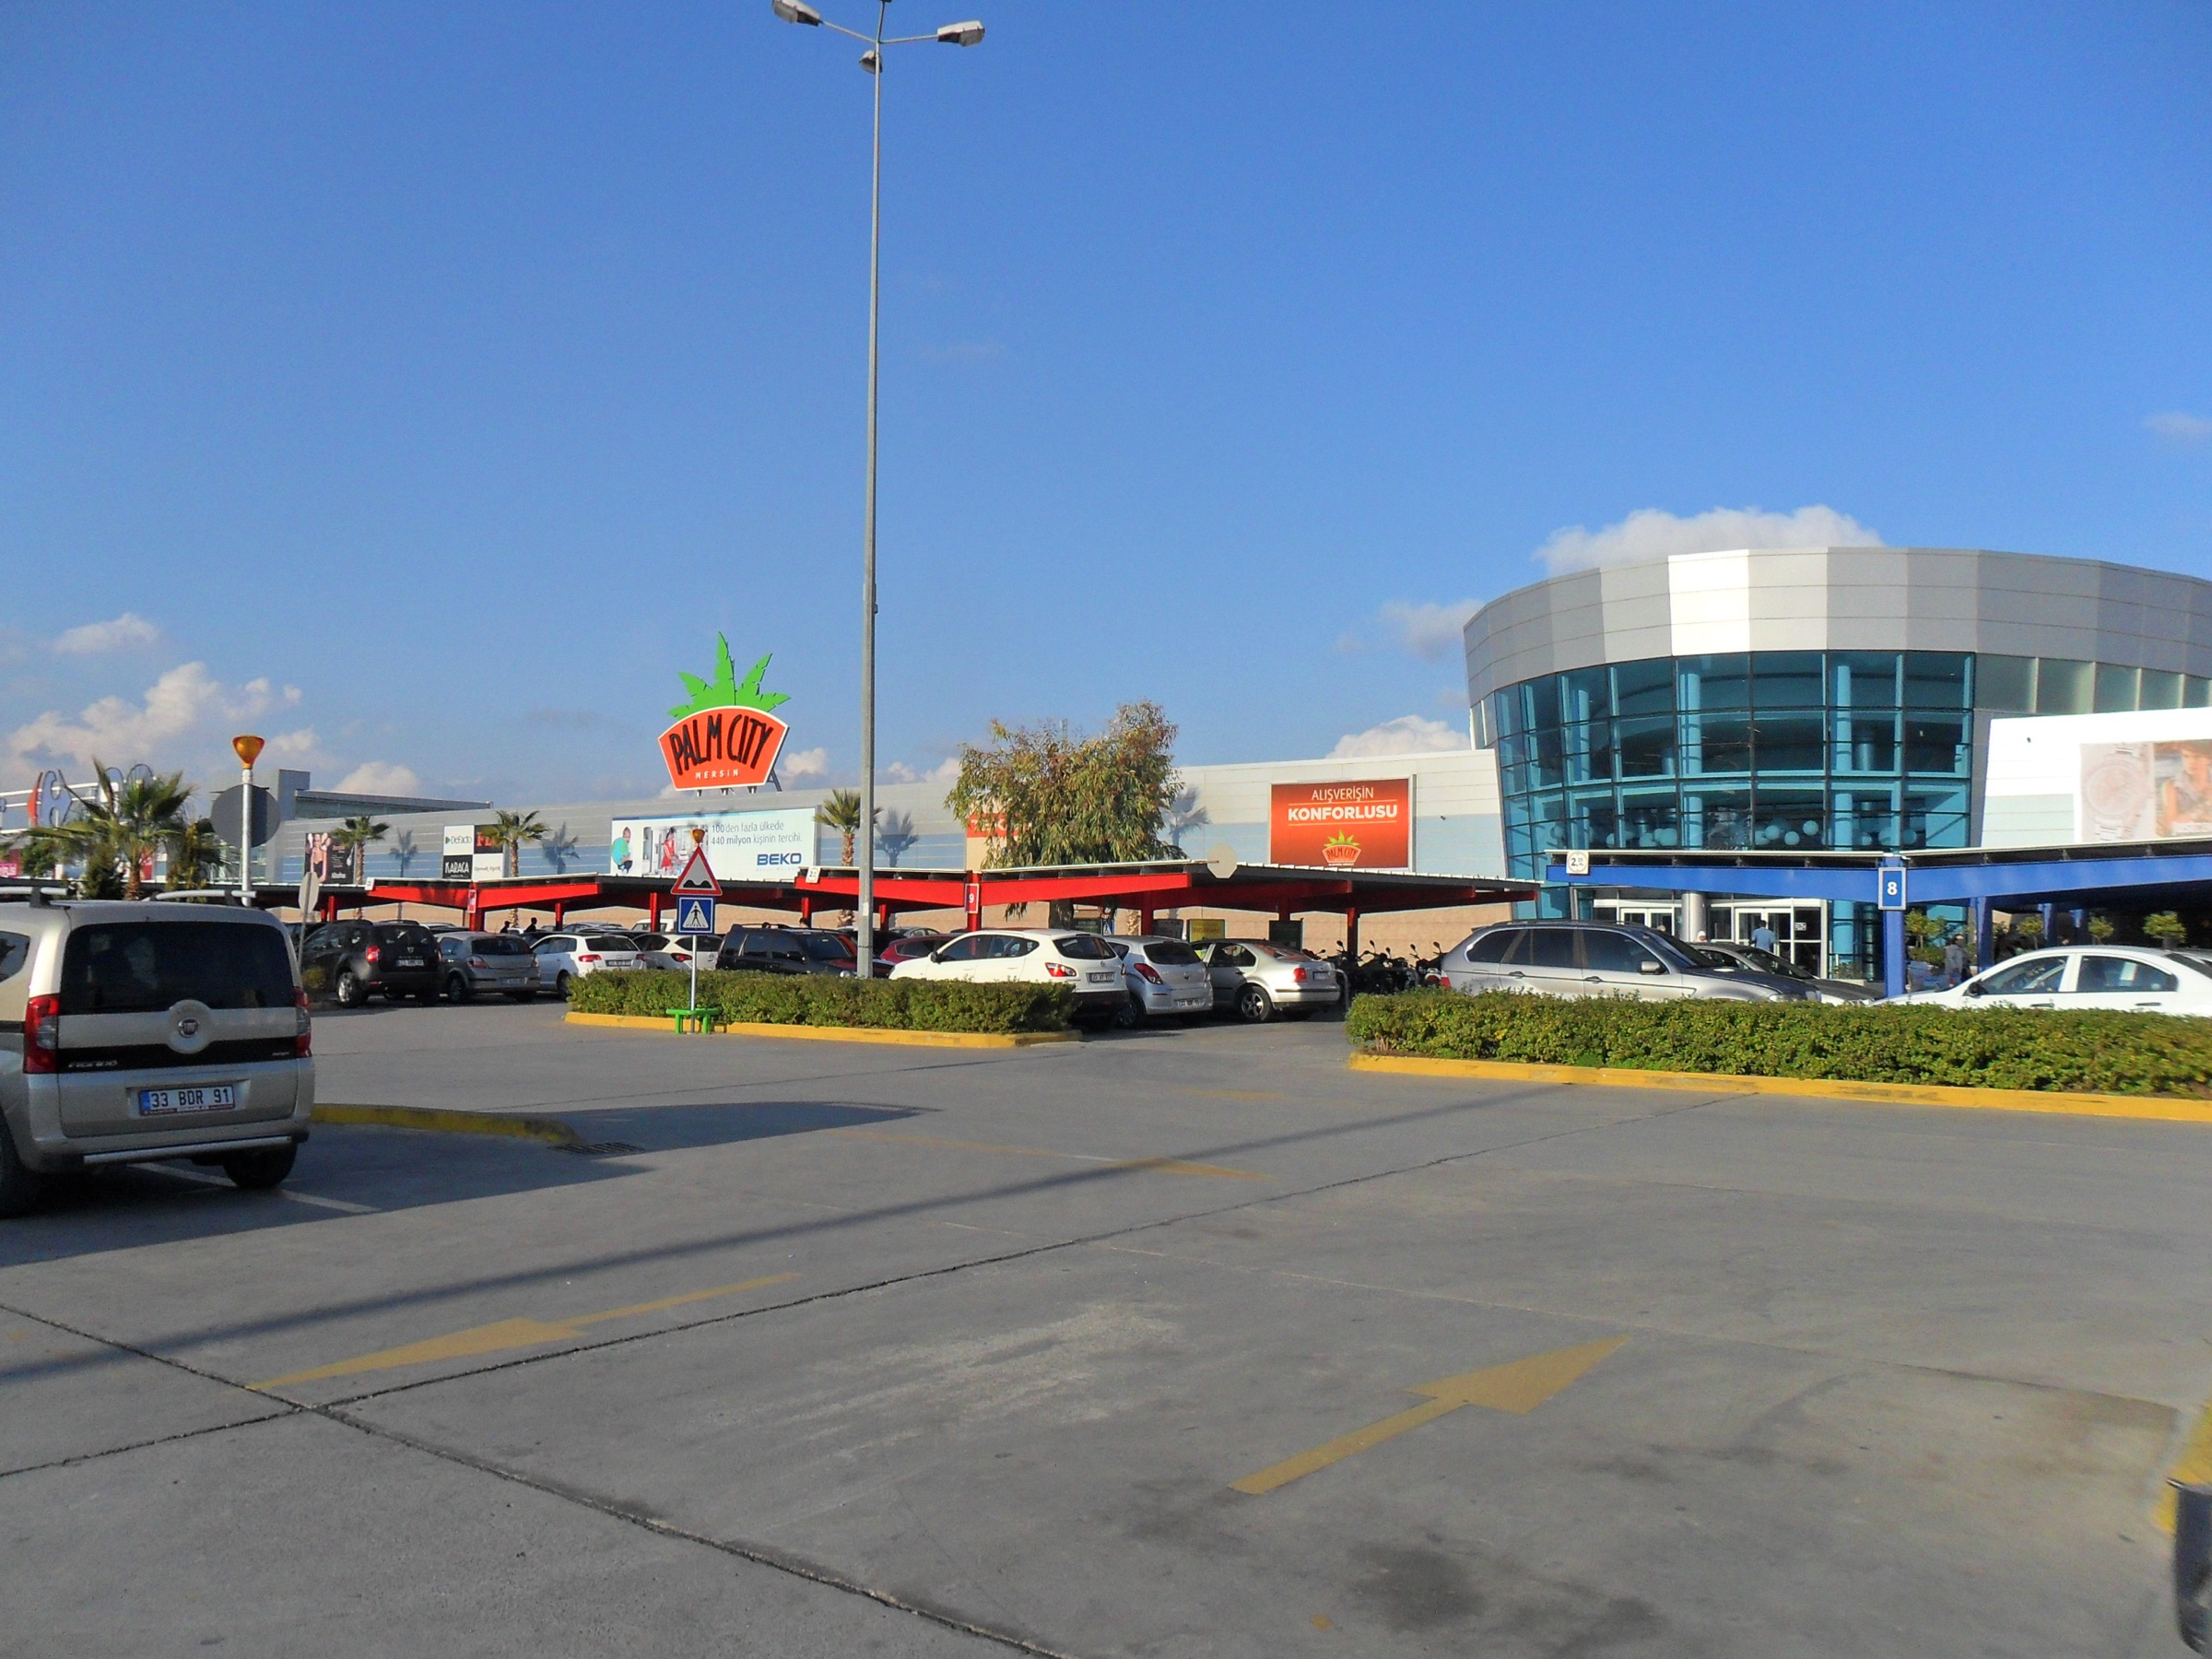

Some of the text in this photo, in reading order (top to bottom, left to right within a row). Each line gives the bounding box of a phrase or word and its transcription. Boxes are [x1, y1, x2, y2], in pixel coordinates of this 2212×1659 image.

[669, 713, 774, 775] PALM CITY
[1312, 785, 1374, 803] ALIŞVERİŞİN
[1288, 804, 1398, 821] KONFORLUSU
[759, 820, 784, 831] ülkede
[711, 836, 724, 845] 440
[726, 834, 751, 847] milyon
[753, 833, 776, 845] kişinin
[757, 853, 802, 865] BEKO
[1326, 846, 1359, 860] PALM CITY
[445, 861, 470, 874] KARACA
[1887, 881, 1899, 896] 8
[969, 893, 975, 903] 9
[150, 1088, 229, 1108] 33 BDR 91
